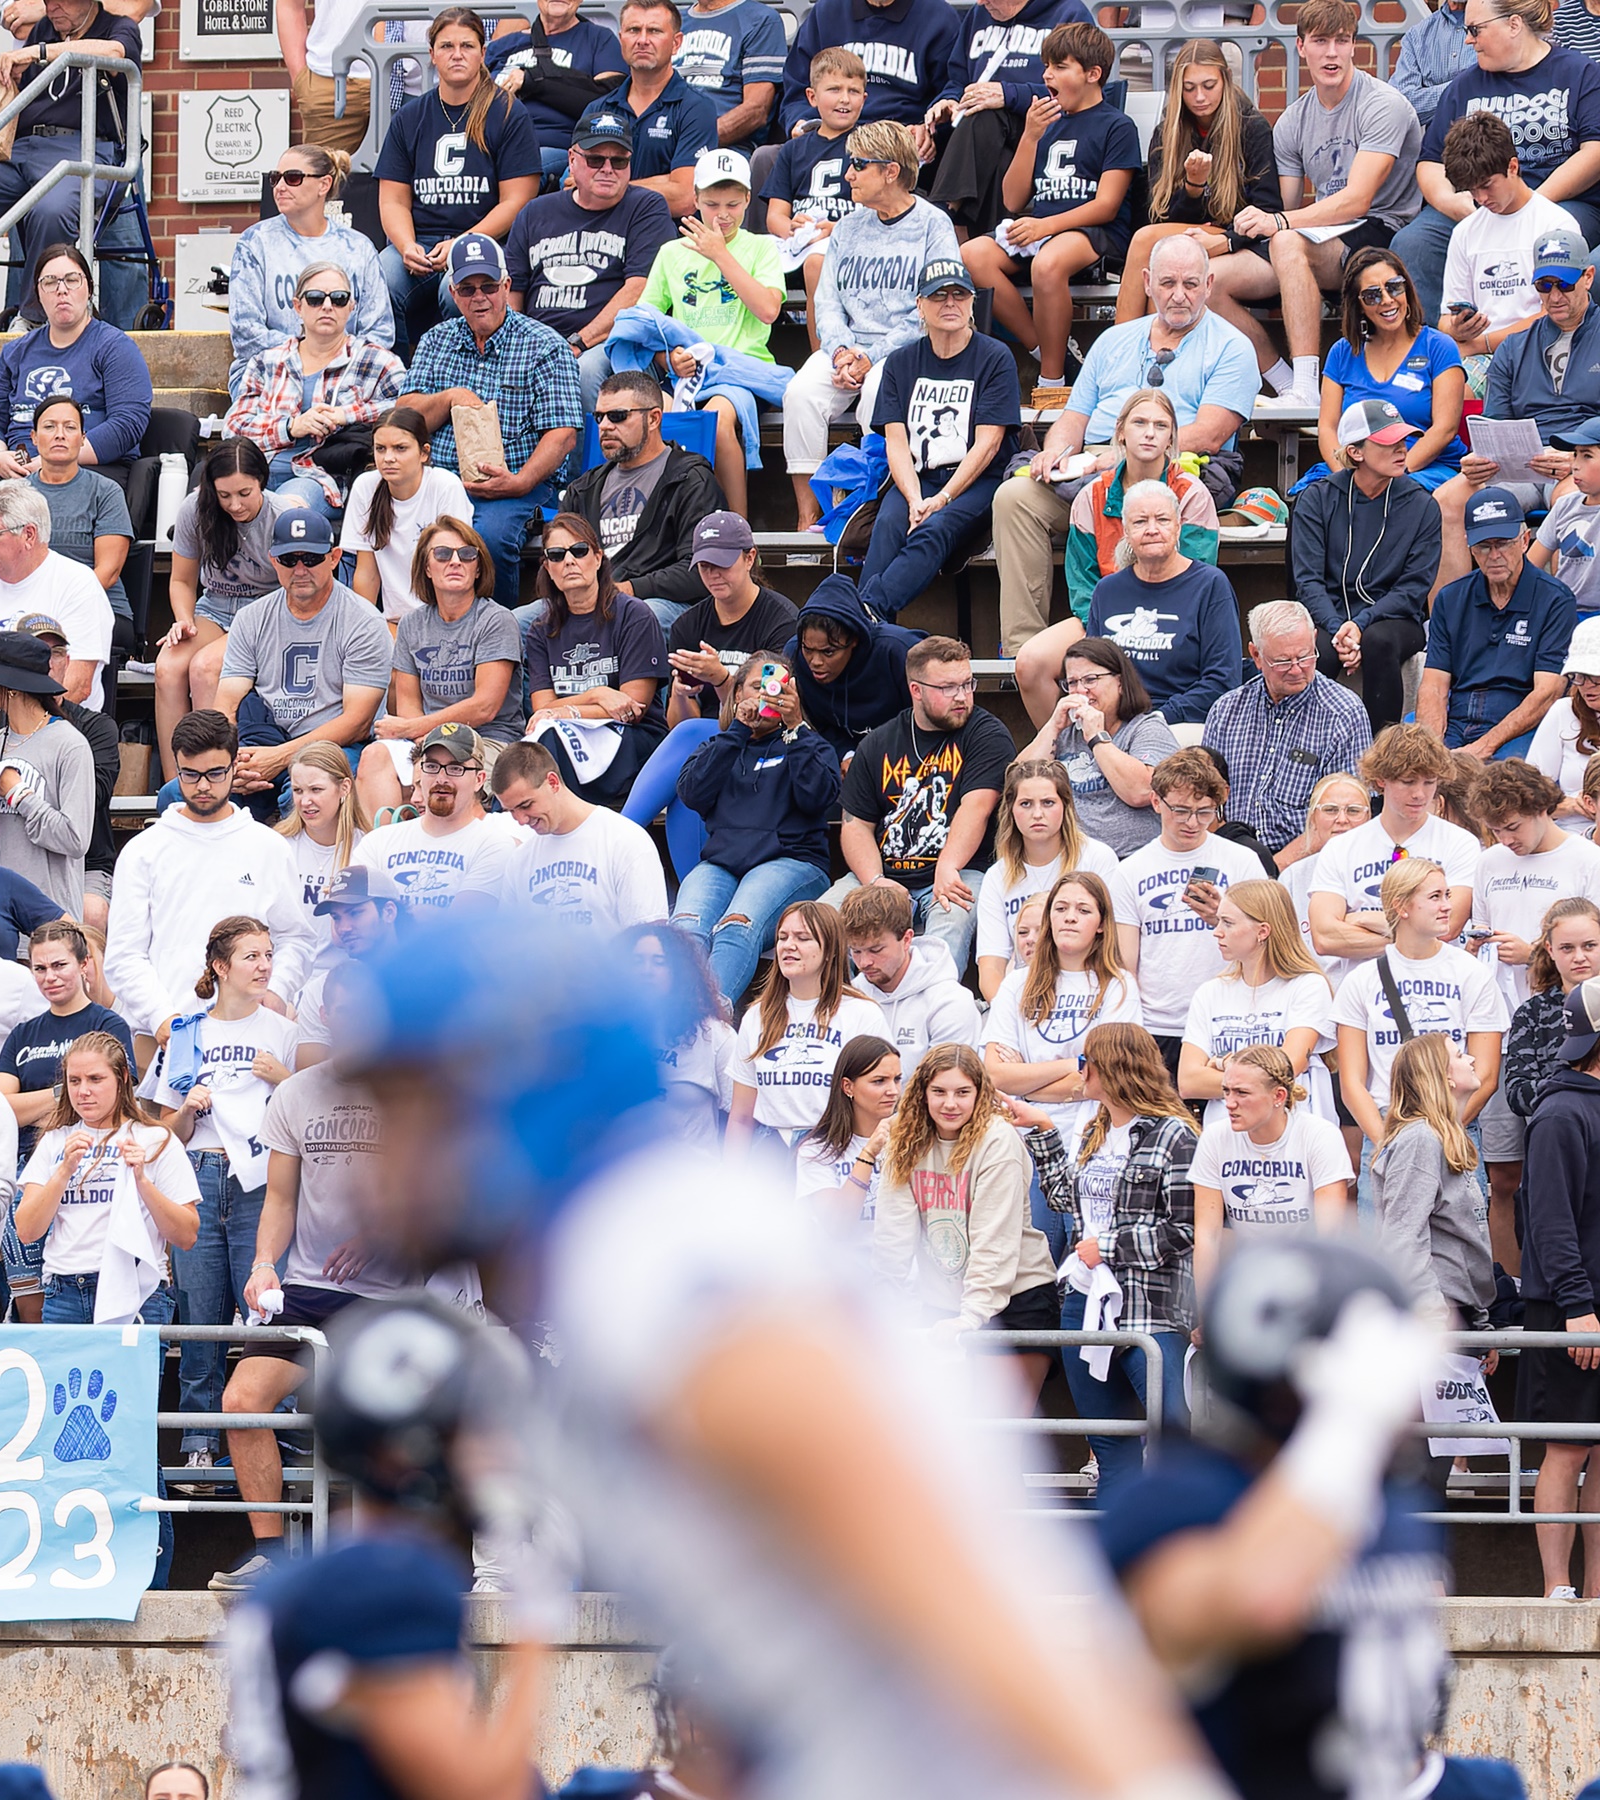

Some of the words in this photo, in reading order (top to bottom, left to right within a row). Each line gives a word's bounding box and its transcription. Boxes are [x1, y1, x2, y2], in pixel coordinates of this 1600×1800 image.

[202, 0, 269, 13] COBBLESTONE
[205, 15, 232, 31] HOTEL
[232, 16, 240, 31] &
[241, 13, 267, 30] SUITES
[224, 108, 244, 118] REED
[216, 123, 252, 133] ELECTRIC
[656, 115, 668, 128] C
[434, 132, 466, 177] C
[1043, 140, 1077, 179] C
[205, 171, 261, 181] GENERAC
[809, 159, 844, 197] C
[414, 176, 489, 195] CONCORDIA
[420, 193, 480, 205] FOOTBALL
[466, 242, 481, 256] C
[837, 255, 917, 292] CONCORDIA
[926, 261, 965, 282] ARMY
[1479, 278, 1527, 290] CONCORDIA
[1491, 287, 1515, 297] TENNIS
[915, 384, 970, 405] NAILED
[911, 405, 927, 422] IT
[291, 520, 306, 538] C
[1515, 620, 1528, 636] C
[282, 642, 323, 698] C
[273, 698, 316, 710] CONCORDIA
[273, 708, 311, 720] FOOTBALL
[882, 753, 912, 791] DEF
[1486, 870, 1521, 898] Concordia
[1491, 885, 1520, 893] UNIVERSITY
[1520, 875, 1560, 893] Nebraska
[755, 1071, 832, 1087] BULLDOGS
[306, 1144, 324, 1152] 2019
[324, 1143, 359, 1152] NATIONAL
[1226, 1208, 1310, 1225] BULLDOGS
